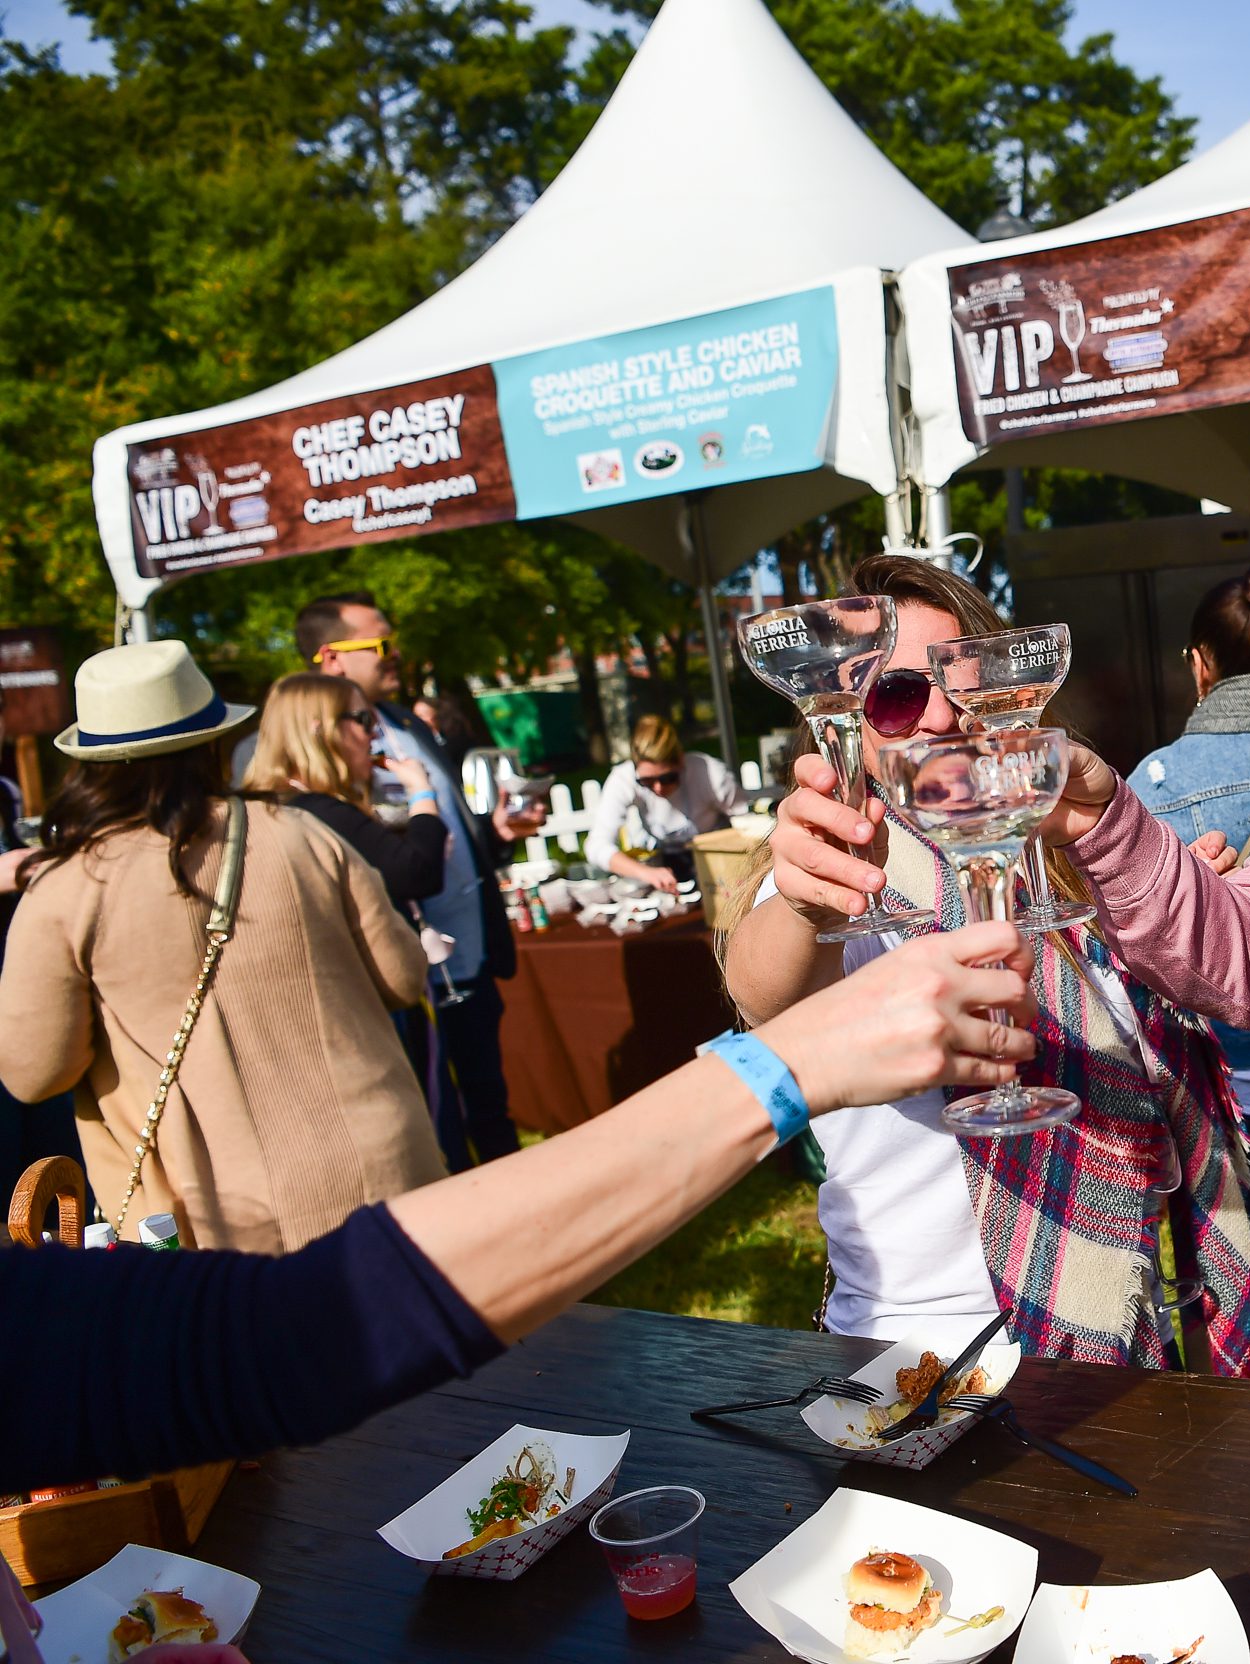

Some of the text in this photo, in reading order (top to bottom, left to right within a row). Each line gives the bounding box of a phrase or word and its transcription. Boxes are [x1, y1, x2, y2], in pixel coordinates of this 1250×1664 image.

[530, 322, 800, 399] SPANISH STYLE CHICKEN
[534, 346, 802, 419] CROQUETTE AND CAVIAR
[965, 319, 1054, 396] VIP
[292, 393, 465, 459] CHEF CASEY
[303, 427, 462, 488] THOMPSON
[136, 485, 200, 544] VIP
[304, 494, 366, 524] Casey
[366, 473, 477, 512] Thompson
[750, 615, 807, 640] GLORIA
[753, 631, 811, 655] FERRER
[1008, 636, 1059, 658] GLORIA
[1010, 651, 1061, 671] FERRER
